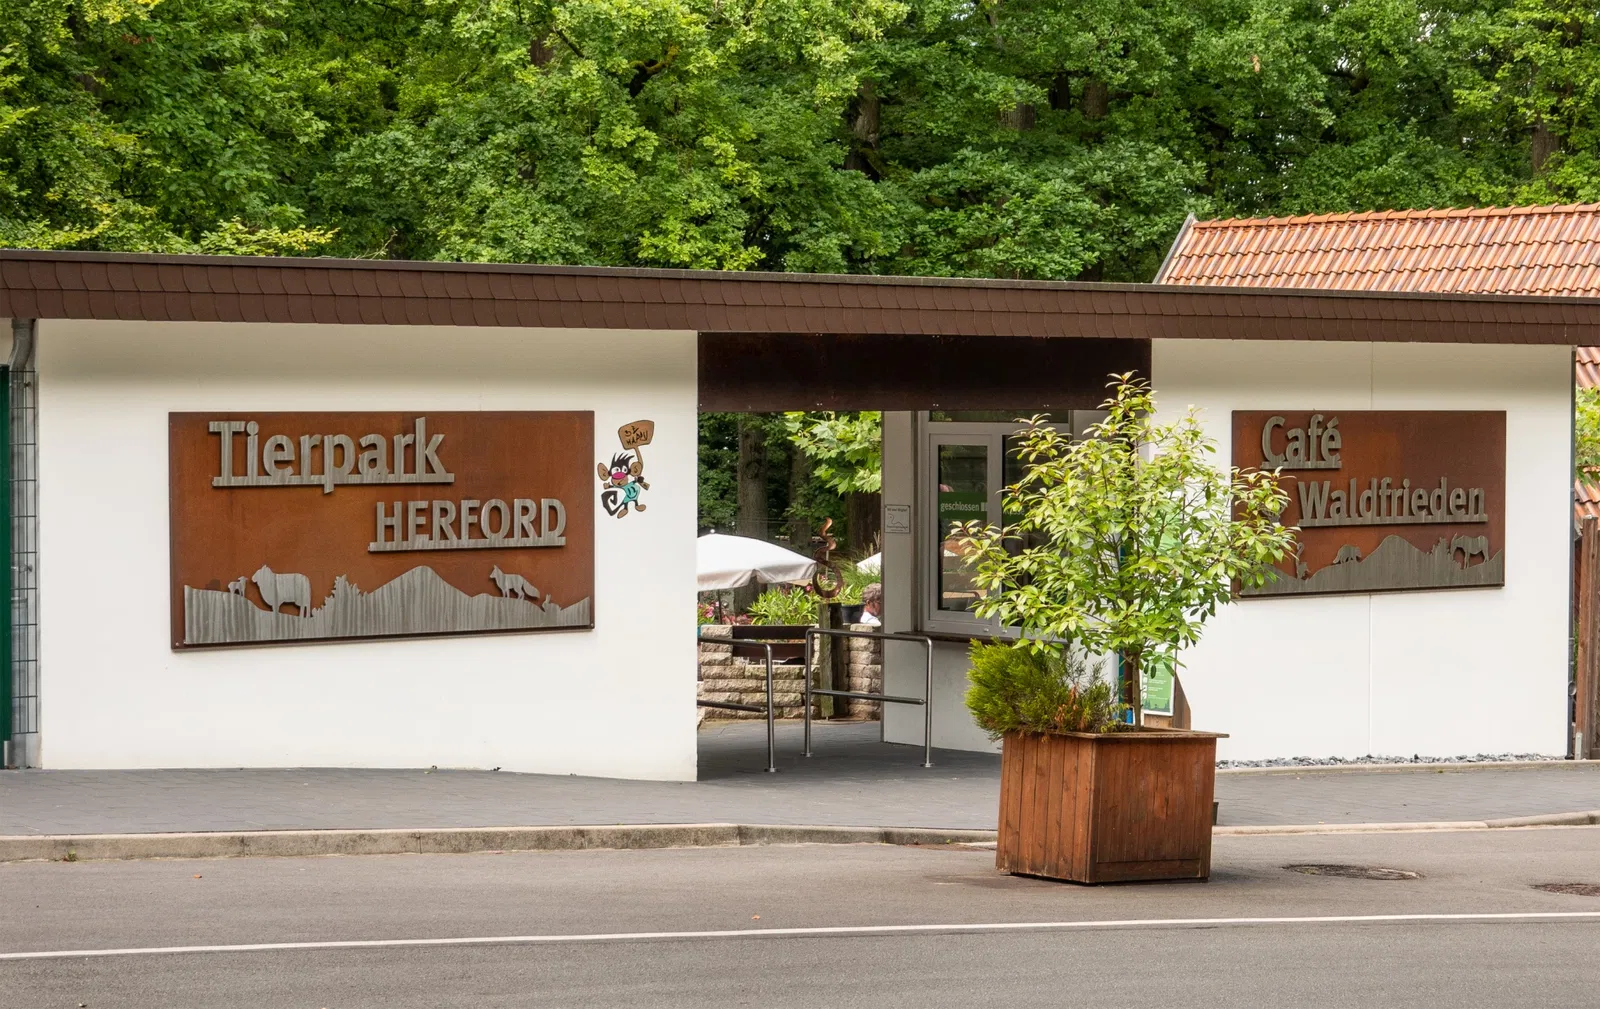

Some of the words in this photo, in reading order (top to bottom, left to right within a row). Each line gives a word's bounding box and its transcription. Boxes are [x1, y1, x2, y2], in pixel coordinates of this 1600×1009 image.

[208, 416, 455, 494] Tierpark
[1260, 414, 1342, 469] Café
[367, 498, 567, 551] HERFORD
[940, 502, 980, 512] geschlossen
[1297, 476, 1488, 527] Waldfrieden
